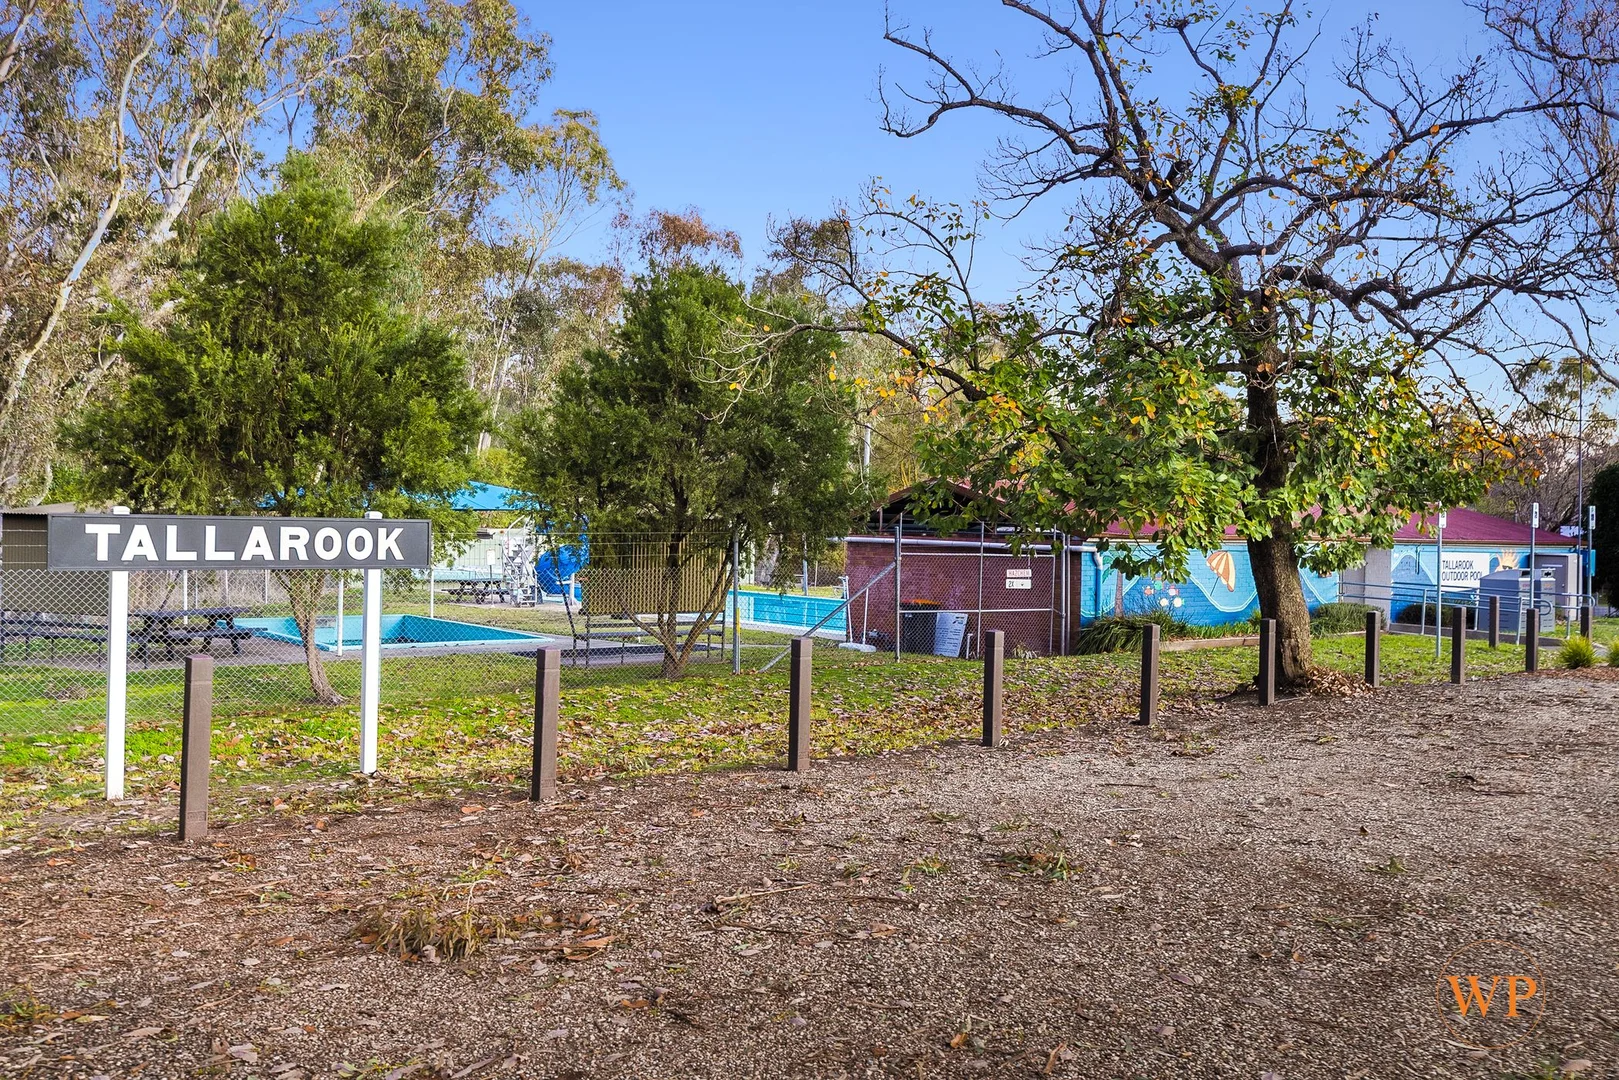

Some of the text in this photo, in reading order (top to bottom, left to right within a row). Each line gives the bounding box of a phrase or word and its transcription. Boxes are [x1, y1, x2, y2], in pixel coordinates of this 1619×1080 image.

[85, 524, 405, 562] TALLAROOK
[1442, 560, 1474, 570] TALLAROOK
[1441, 571, 1469, 581] OUTDOOR
